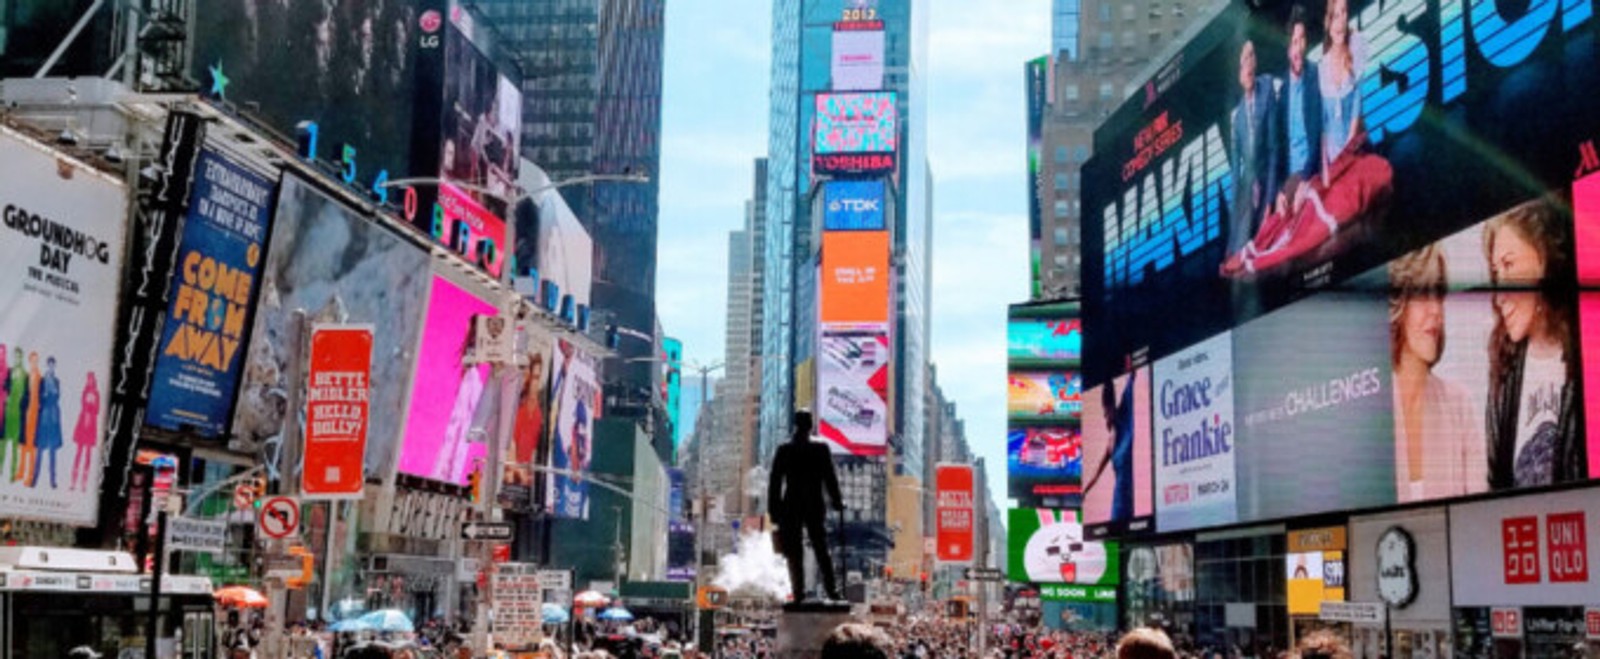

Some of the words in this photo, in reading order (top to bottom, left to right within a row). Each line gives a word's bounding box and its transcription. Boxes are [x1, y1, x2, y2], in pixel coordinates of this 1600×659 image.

[420, 36, 439, 48] LG
[816, 155, 893, 170] TOSHIBA
[842, 199, 879, 212] TDK
[1103, 122, 1234, 288] MAKIN
[2, 203, 110, 265] GROUNDHOG
[40, 243, 72, 274] DAY
[183, 250, 253, 305] COME
[173, 284, 247, 341] FROM
[164, 322, 240, 373] AWAY
[310, 386, 368, 402] MIDLER
[314, 371, 365, 386] BETTE
[1285, 366, 1381, 416] CHALLENGES
[1160, 376, 1212, 420] Grace
[1163, 413, 1232, 467] Frankie
[1550, 521, 1579, 545] UNI
[1552, 551, 1584, 578] QLO
[1057, 588, 1086, 598] SOON
